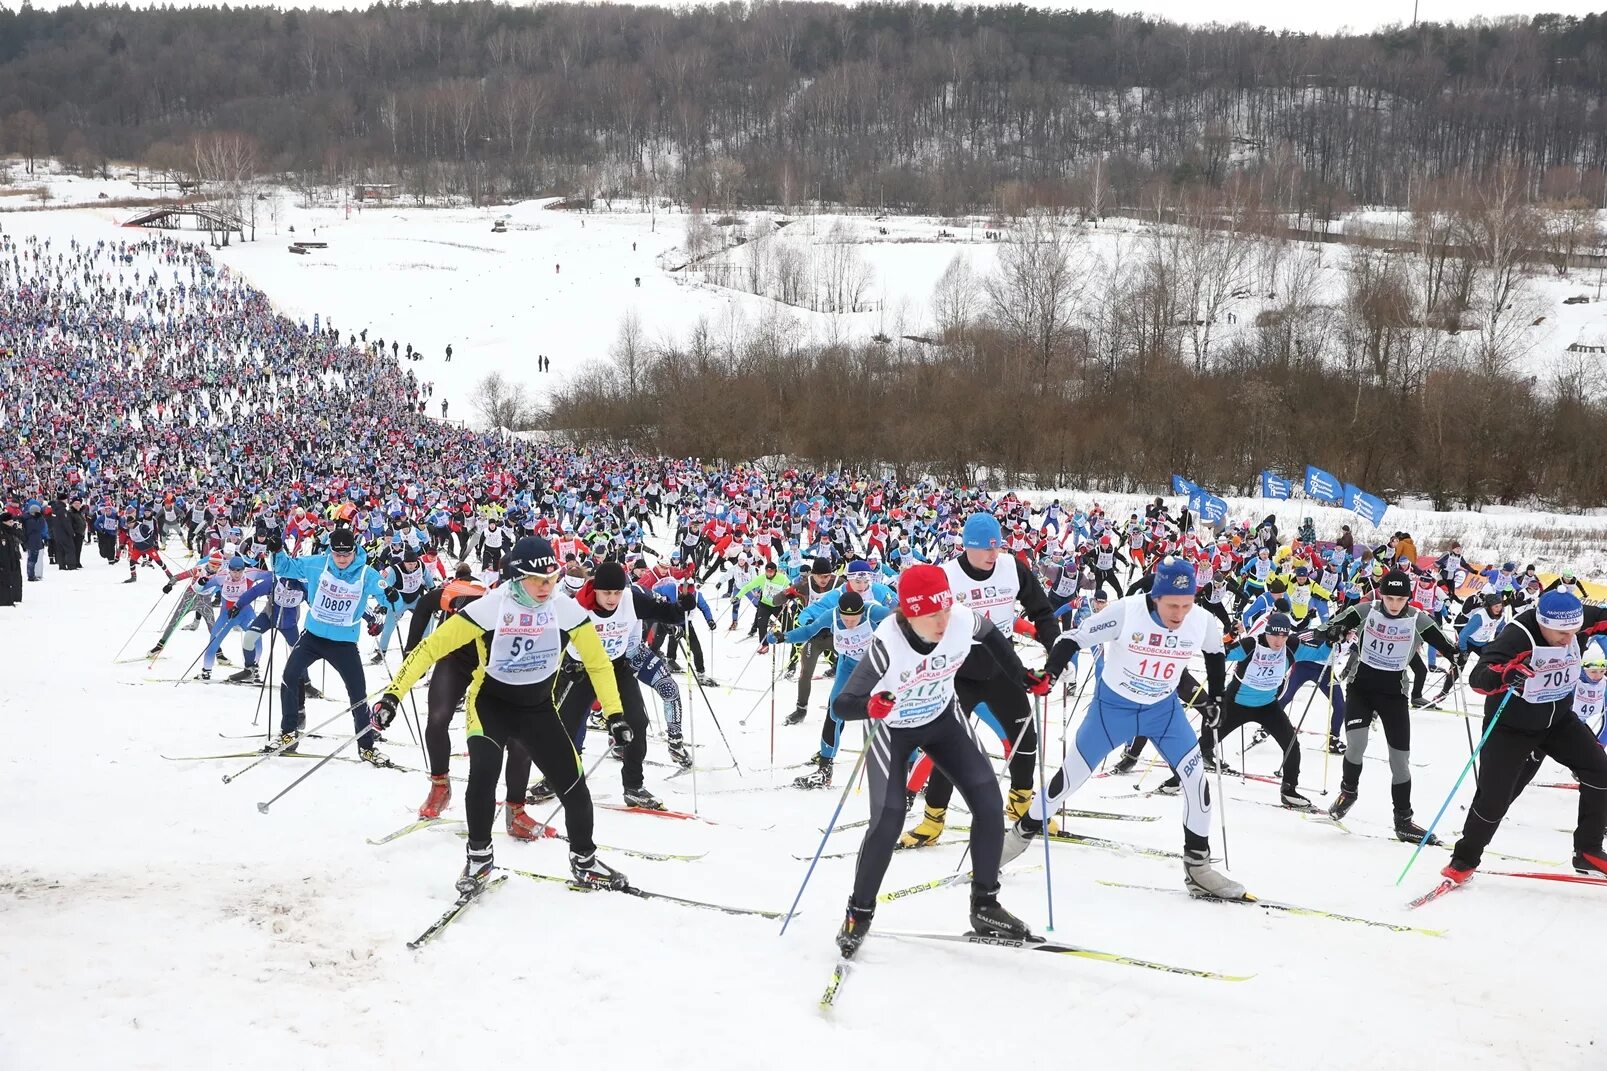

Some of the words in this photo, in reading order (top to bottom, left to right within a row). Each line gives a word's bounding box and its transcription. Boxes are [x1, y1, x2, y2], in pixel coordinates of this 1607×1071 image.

[320, 595, 352, 612] 10809
[1089, 620, 1117, 634] BRIKO
[1128, 644, 1171, 656] МОСКОВСКАЯ
[1171, 649, 1193, 657] ЛЫЖНЯ
[1370, 639, 1394, 656] 419
[1139, 659, 1176, 680] 116
[1543, 668, 1569, 687] 706
[1581, 704, 1595, 716] 49
[894, 883, 931, 899] FISCHER
[977, 914, 1012, 929] SALOMON
[968, 937, 1024, 948] FISCHER
